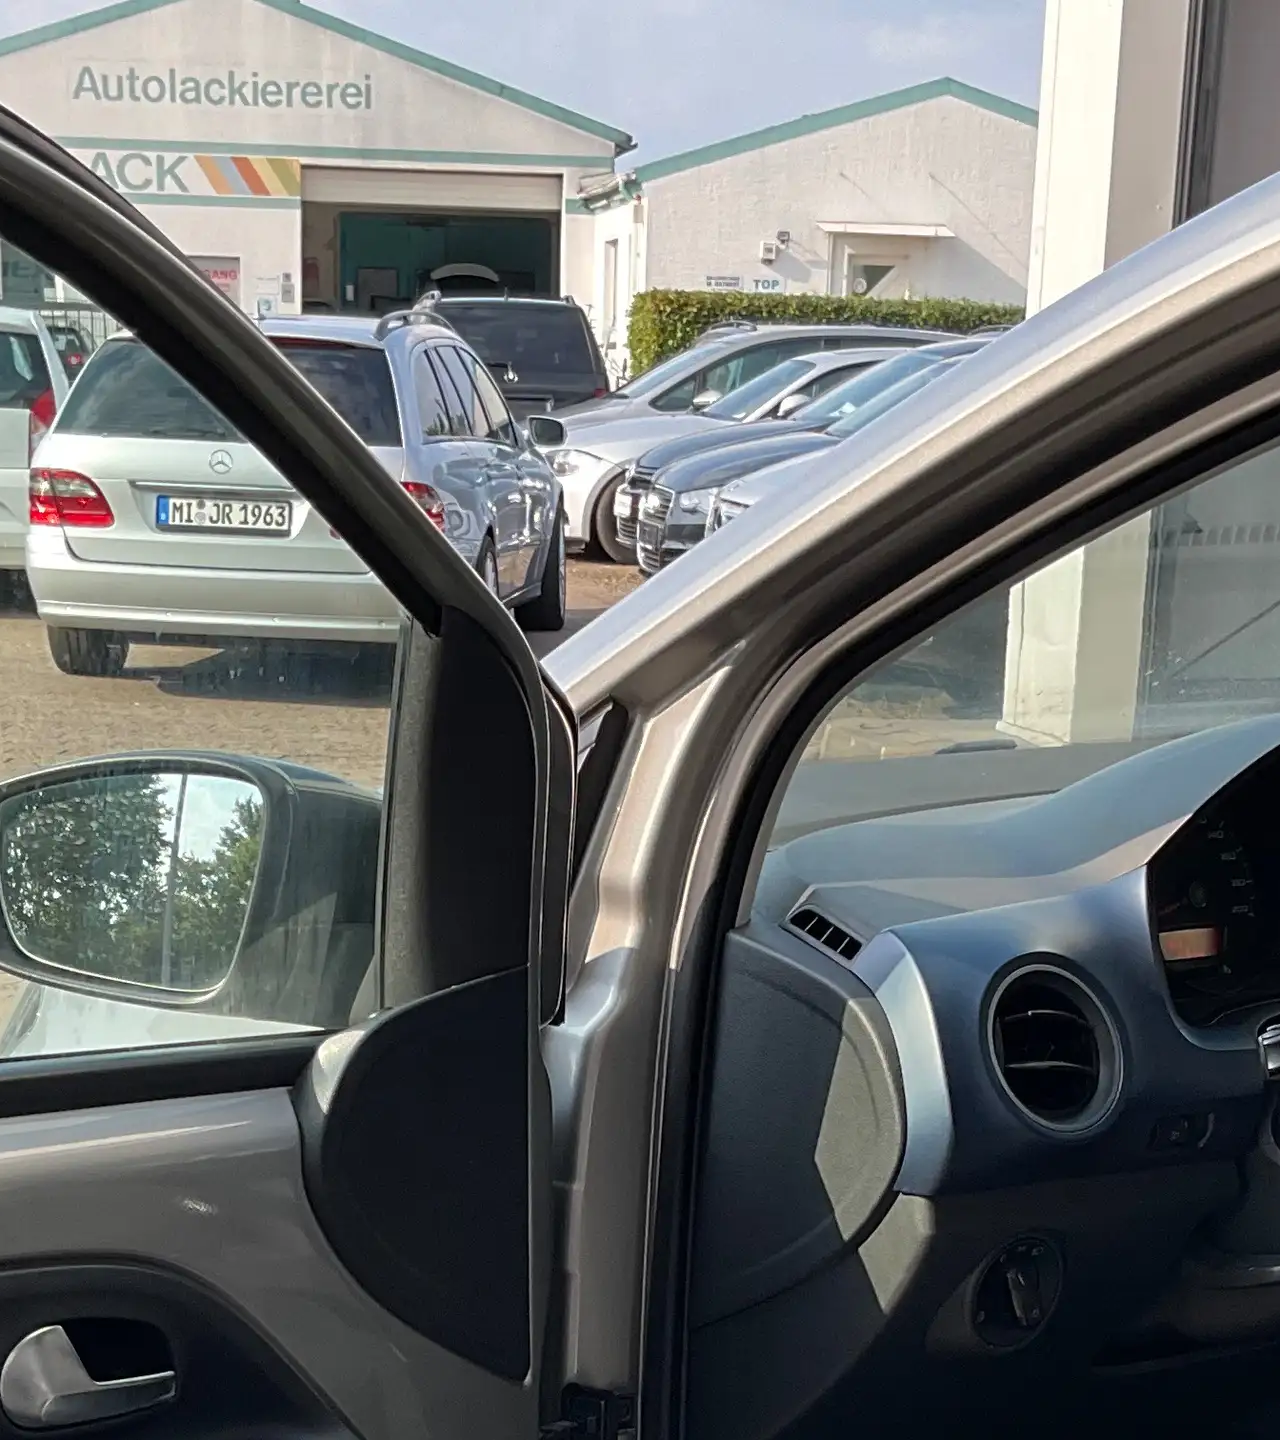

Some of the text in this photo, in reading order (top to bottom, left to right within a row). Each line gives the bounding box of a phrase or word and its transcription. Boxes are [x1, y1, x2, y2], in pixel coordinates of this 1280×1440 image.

[72, 65, 372, 110] Autolackiererei
[753, 279, 780, 290] TOP
[171, 502, 287, 527] MI JR 1963
